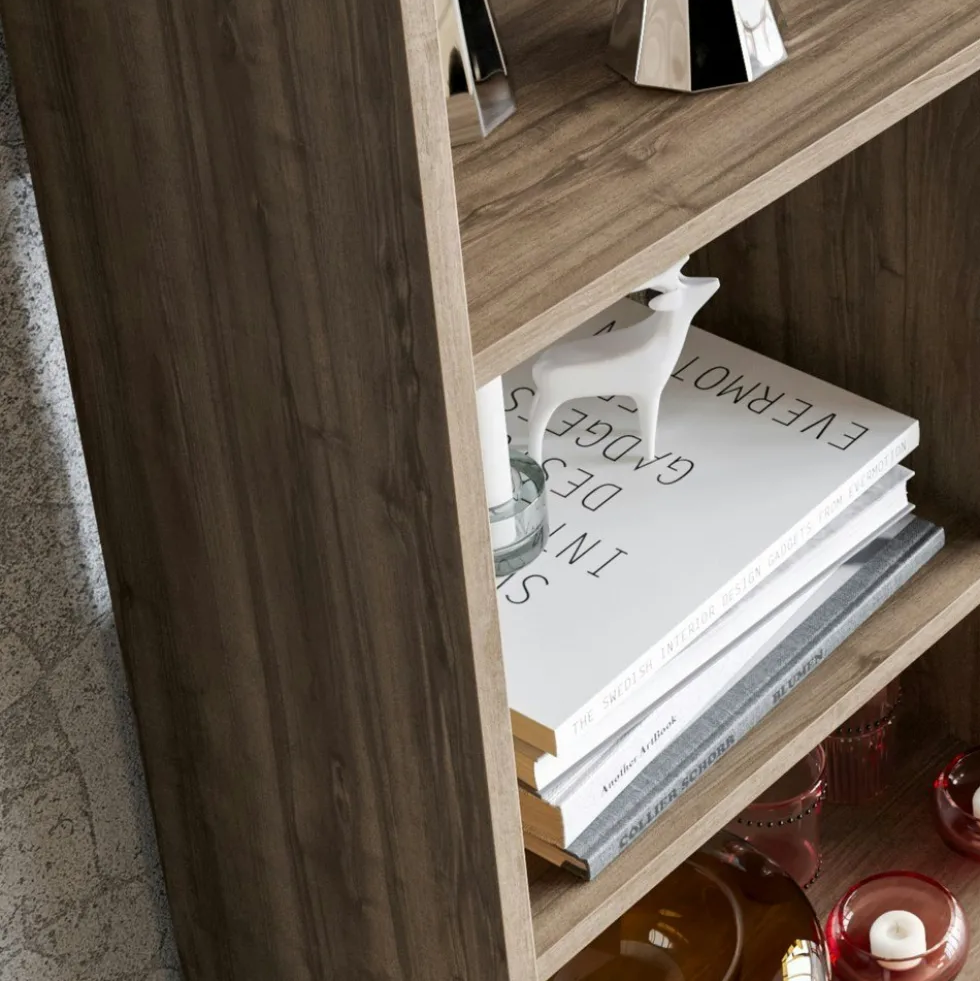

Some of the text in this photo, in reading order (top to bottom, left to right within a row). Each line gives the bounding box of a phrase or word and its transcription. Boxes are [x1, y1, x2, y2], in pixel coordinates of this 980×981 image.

[671, 356, 869, 453] EVERMOT
[571, 440, 908, 736] THE SWEDISH INTERIOR DESIGN GADGETS FROM EVERMOTION
[600, 715, 678, 795] Another ArtBook
[617, 648, 824, 849] COLLIER SCHORR BLUMEN
